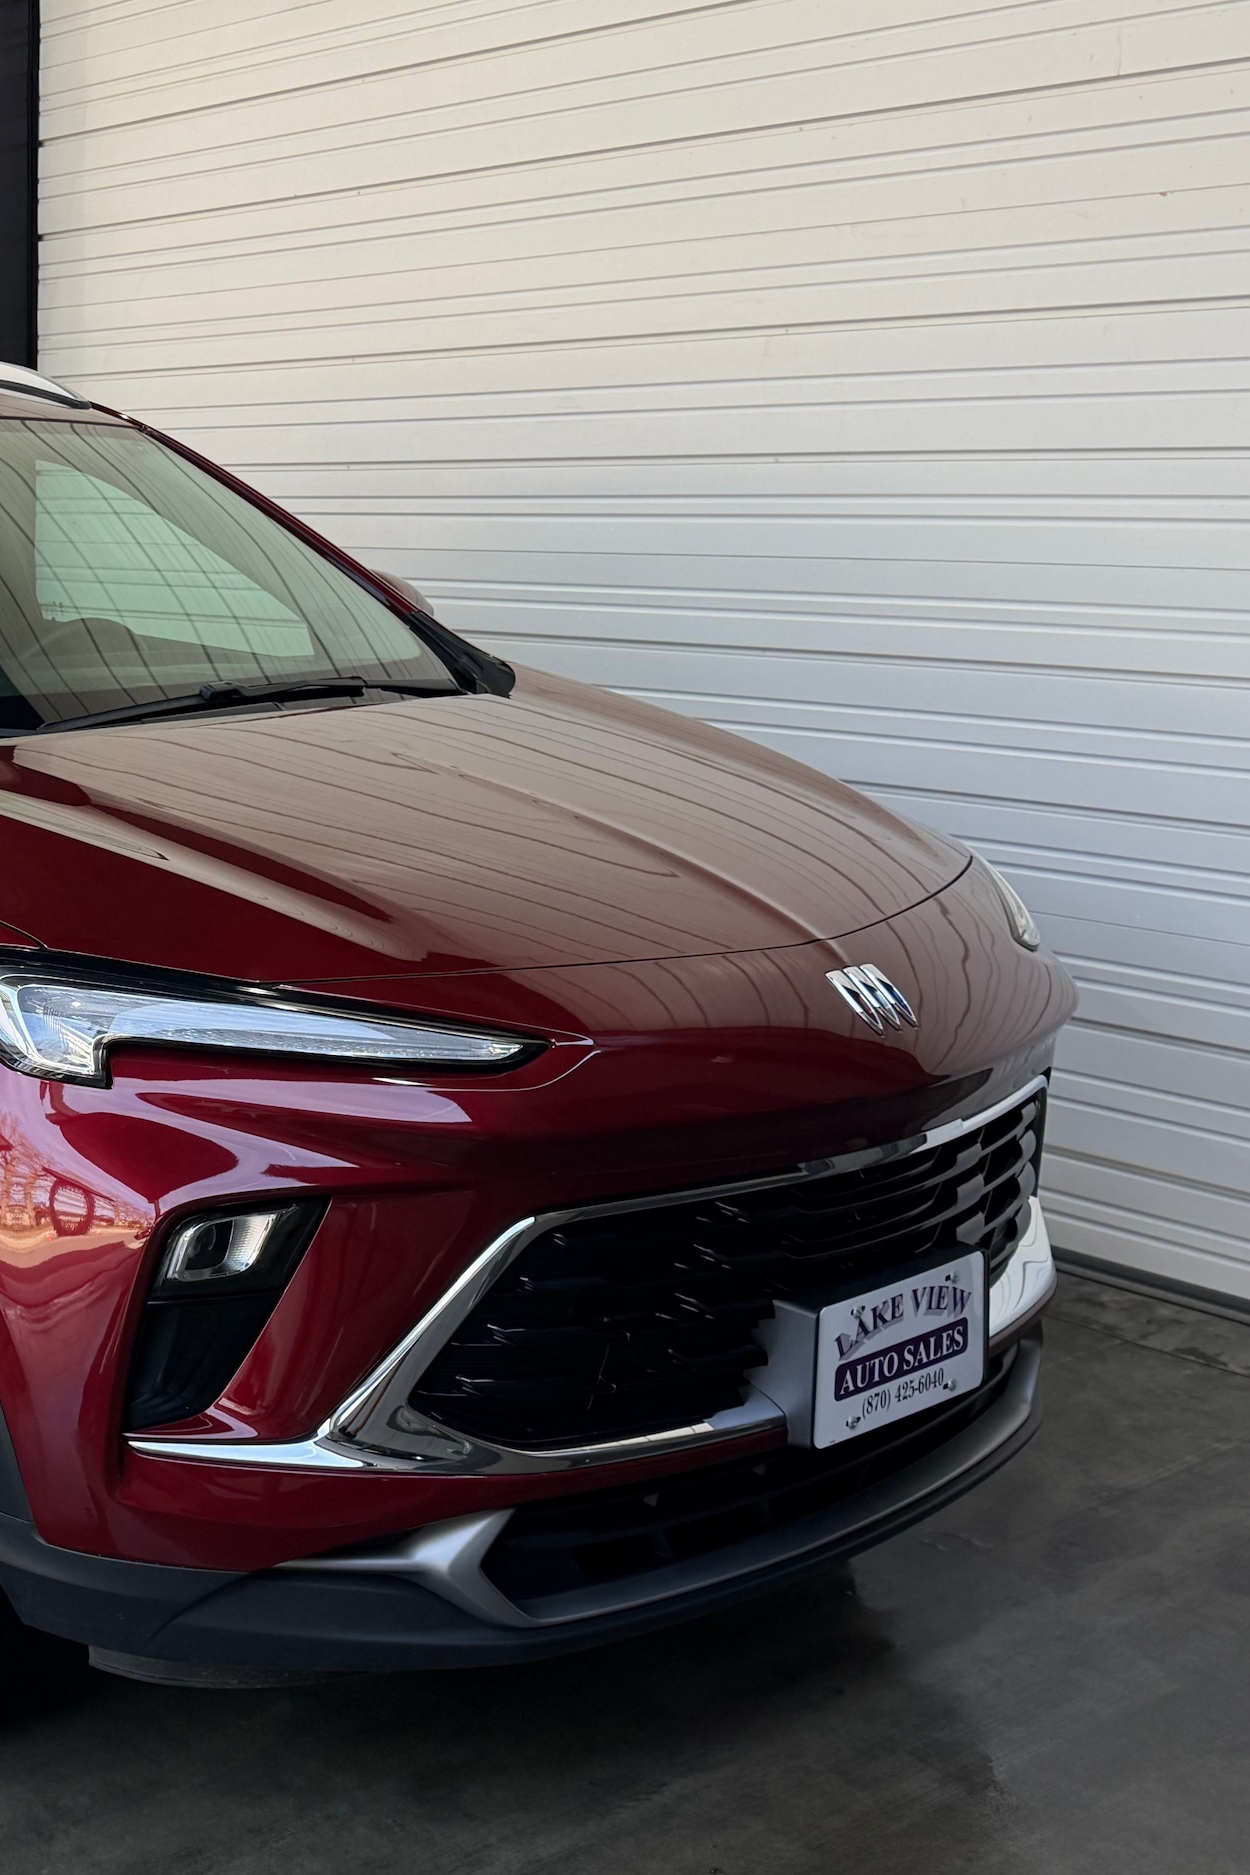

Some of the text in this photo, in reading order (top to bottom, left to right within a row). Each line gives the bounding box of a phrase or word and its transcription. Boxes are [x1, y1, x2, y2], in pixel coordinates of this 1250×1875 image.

[834, 1285, 972, 1359] LAKE VIEW
[839, 1325, 965, 1395] AUTO SALES
[861, 1367, 944, 1420] (870) 425-6040
